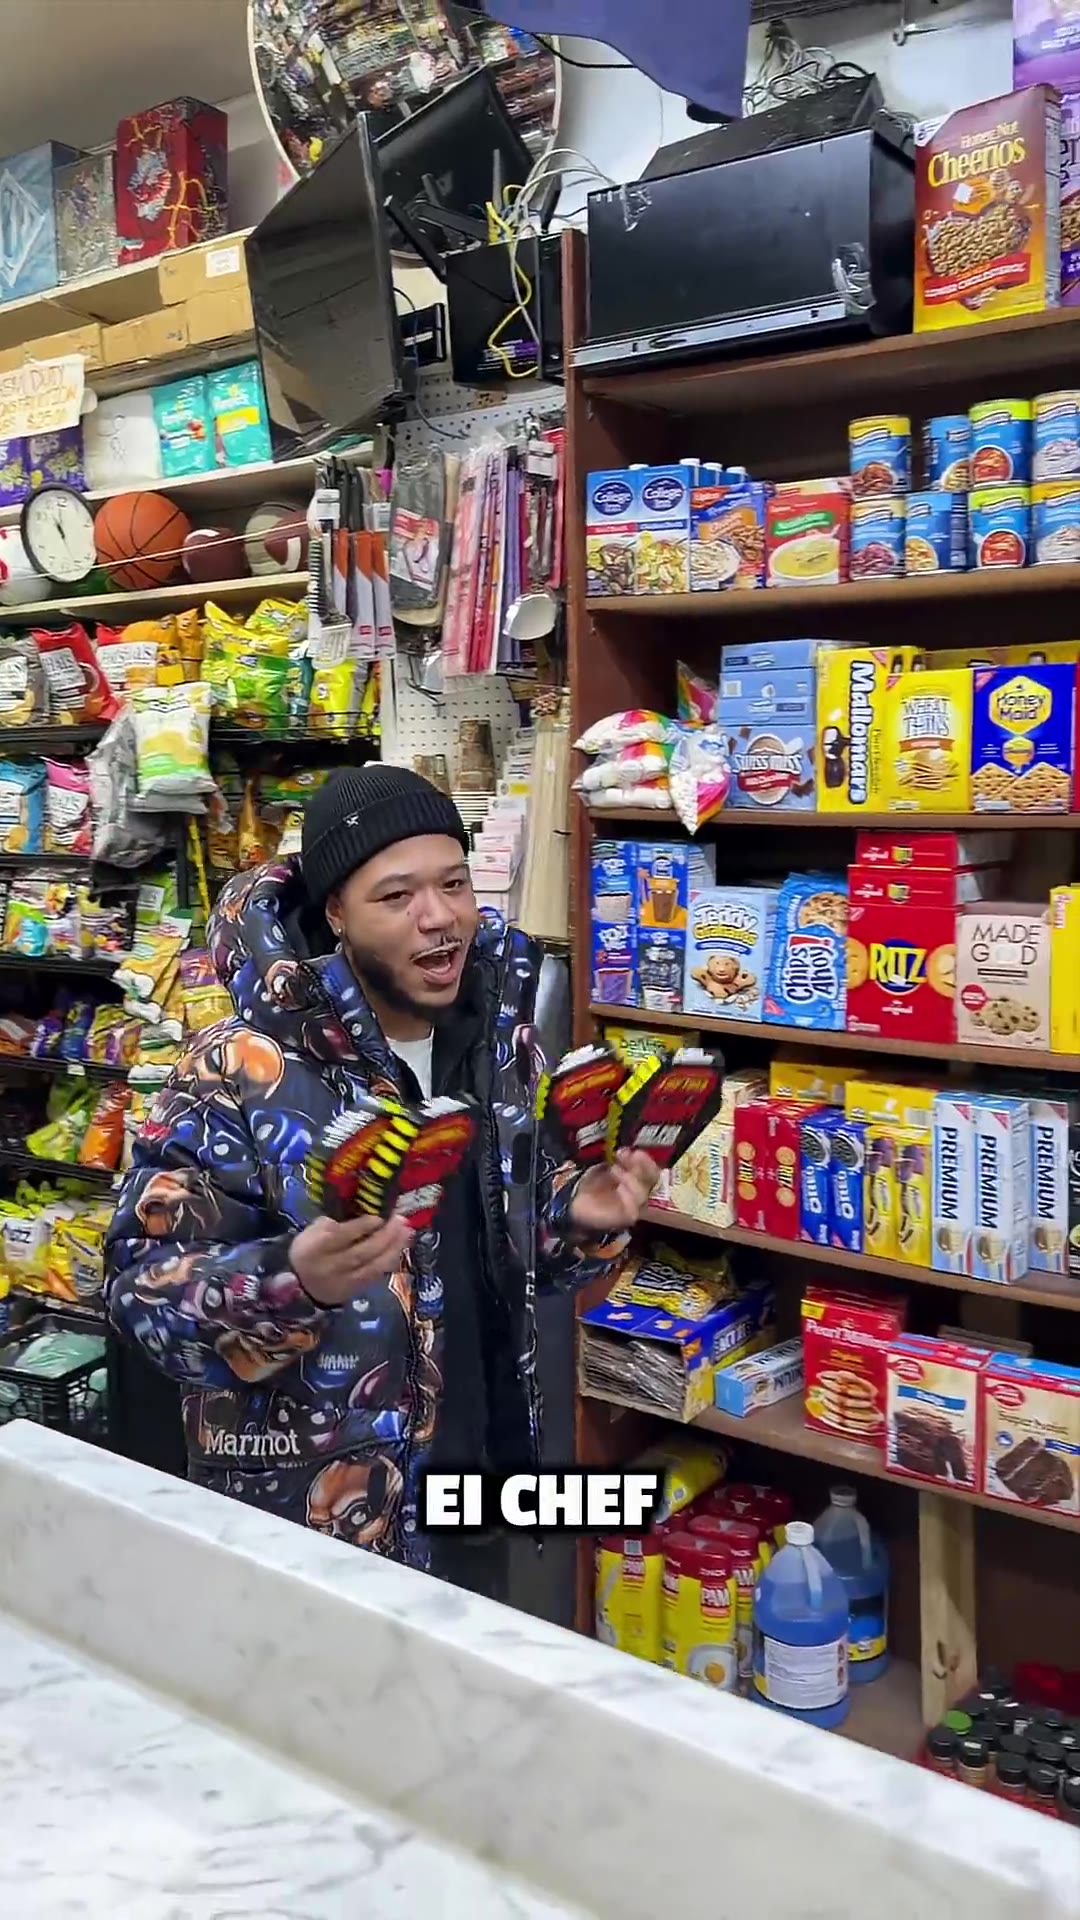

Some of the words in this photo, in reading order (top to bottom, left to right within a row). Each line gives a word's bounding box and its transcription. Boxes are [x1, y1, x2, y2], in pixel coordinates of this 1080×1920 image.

[928, 137, 1026, 187] Cheerios
[997, 692, 1046, 711] Honey
[1000, 707, 1038, 722] Maid
[694, 906, 759, 932] Teddy
[972, 924, 1042, 945] MADE
[869, 942, 928, 985] RITZ
[971, 943, 1038, 965] GD
[786, 947, 809, 1002] Chips
[941, 1126, 959, 1220] PREMIUM
[980, 1134, 998, 1229] PREMIUM
[1037, 1126, 1055, 1220] PREMIUM
[805, 1318, 839, 1340] Pearl
[204, 1430, 300, 1458] Marmot
[701, 1587, 730, 1607] PAM
